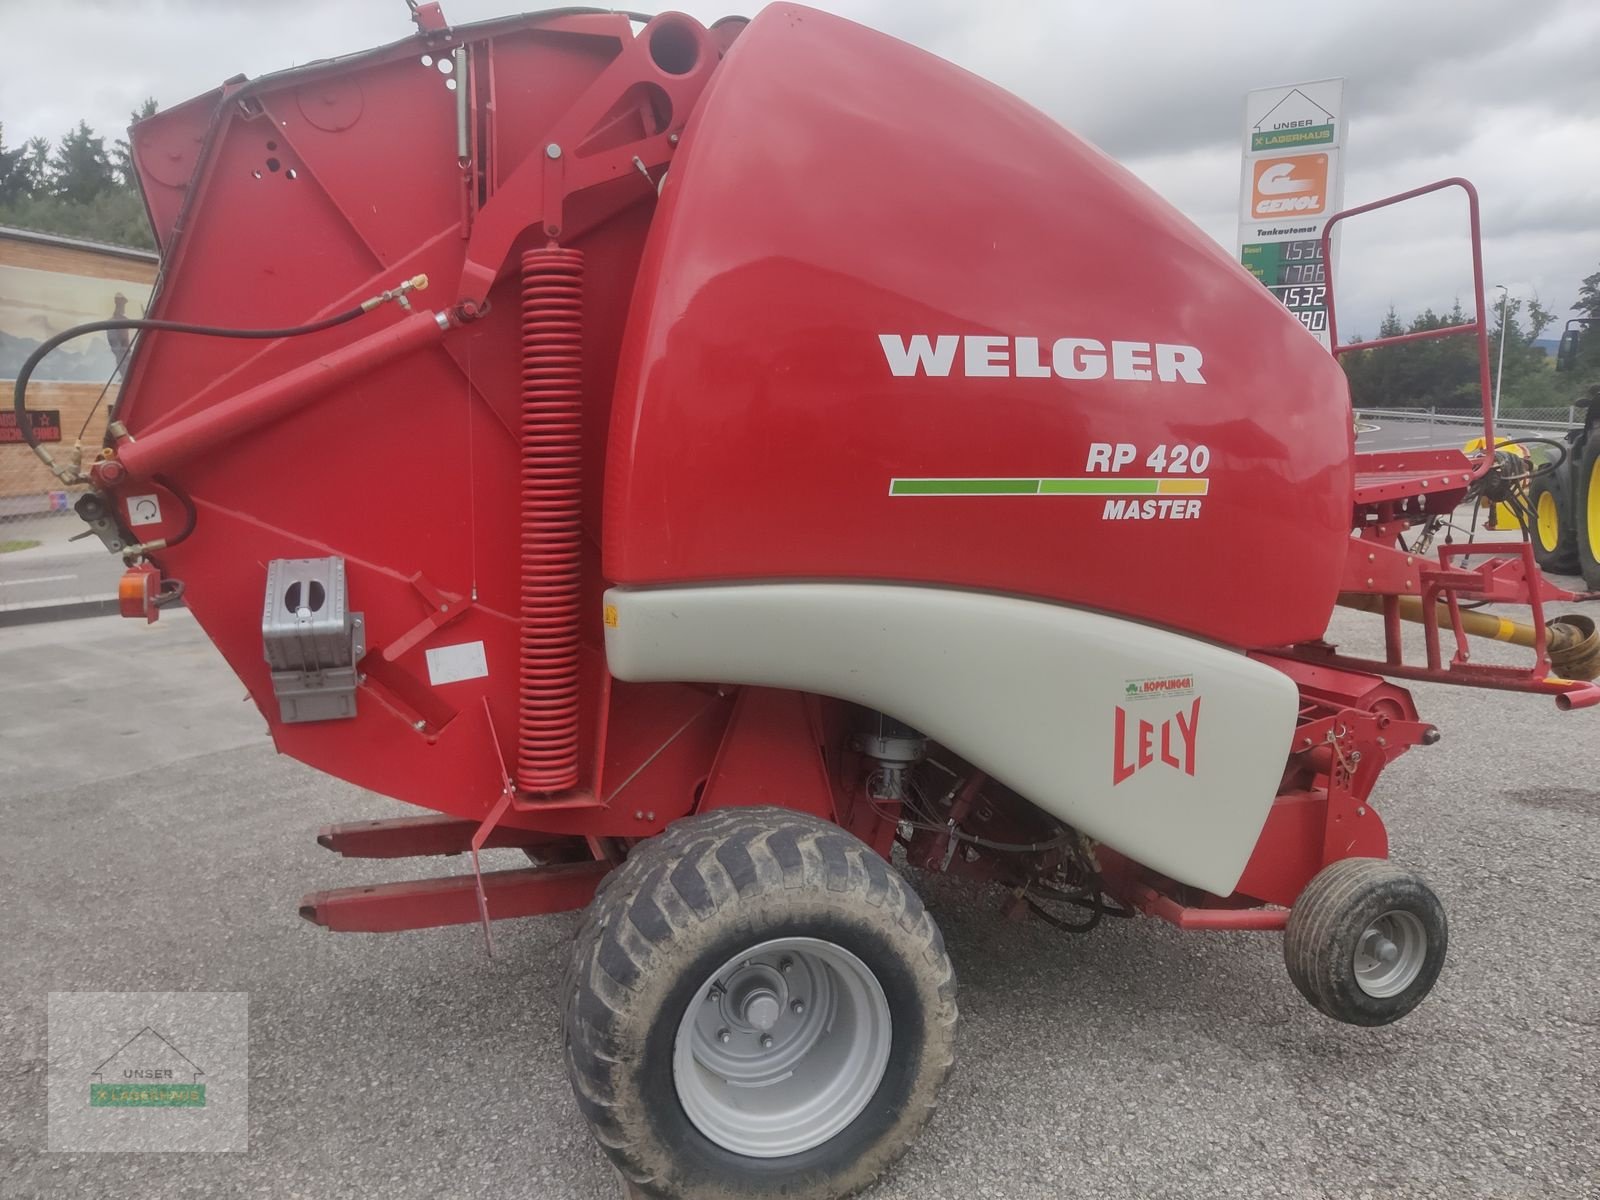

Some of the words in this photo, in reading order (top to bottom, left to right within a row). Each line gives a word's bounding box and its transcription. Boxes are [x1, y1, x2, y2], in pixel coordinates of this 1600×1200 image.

[1273, 119, 1313, 130] UNSER
[1265, 130, 1330, 145] LAGERHAUS
[1256, 196, 1320, 213] GENOL
[1257, 226, 1317, 236] Tankautomat
[1283, 287, 1326, 307] 1.532
[1291, 311, 1325, 330] 90
[878, 334, 1207, 384] WELGER
[1085, 442, 1137, 473] RP
[1146, 444, 1210, 474] 420
[1102, 500, 1202, 520] MASTER
[1113, 695, 1202, 787] LELY
